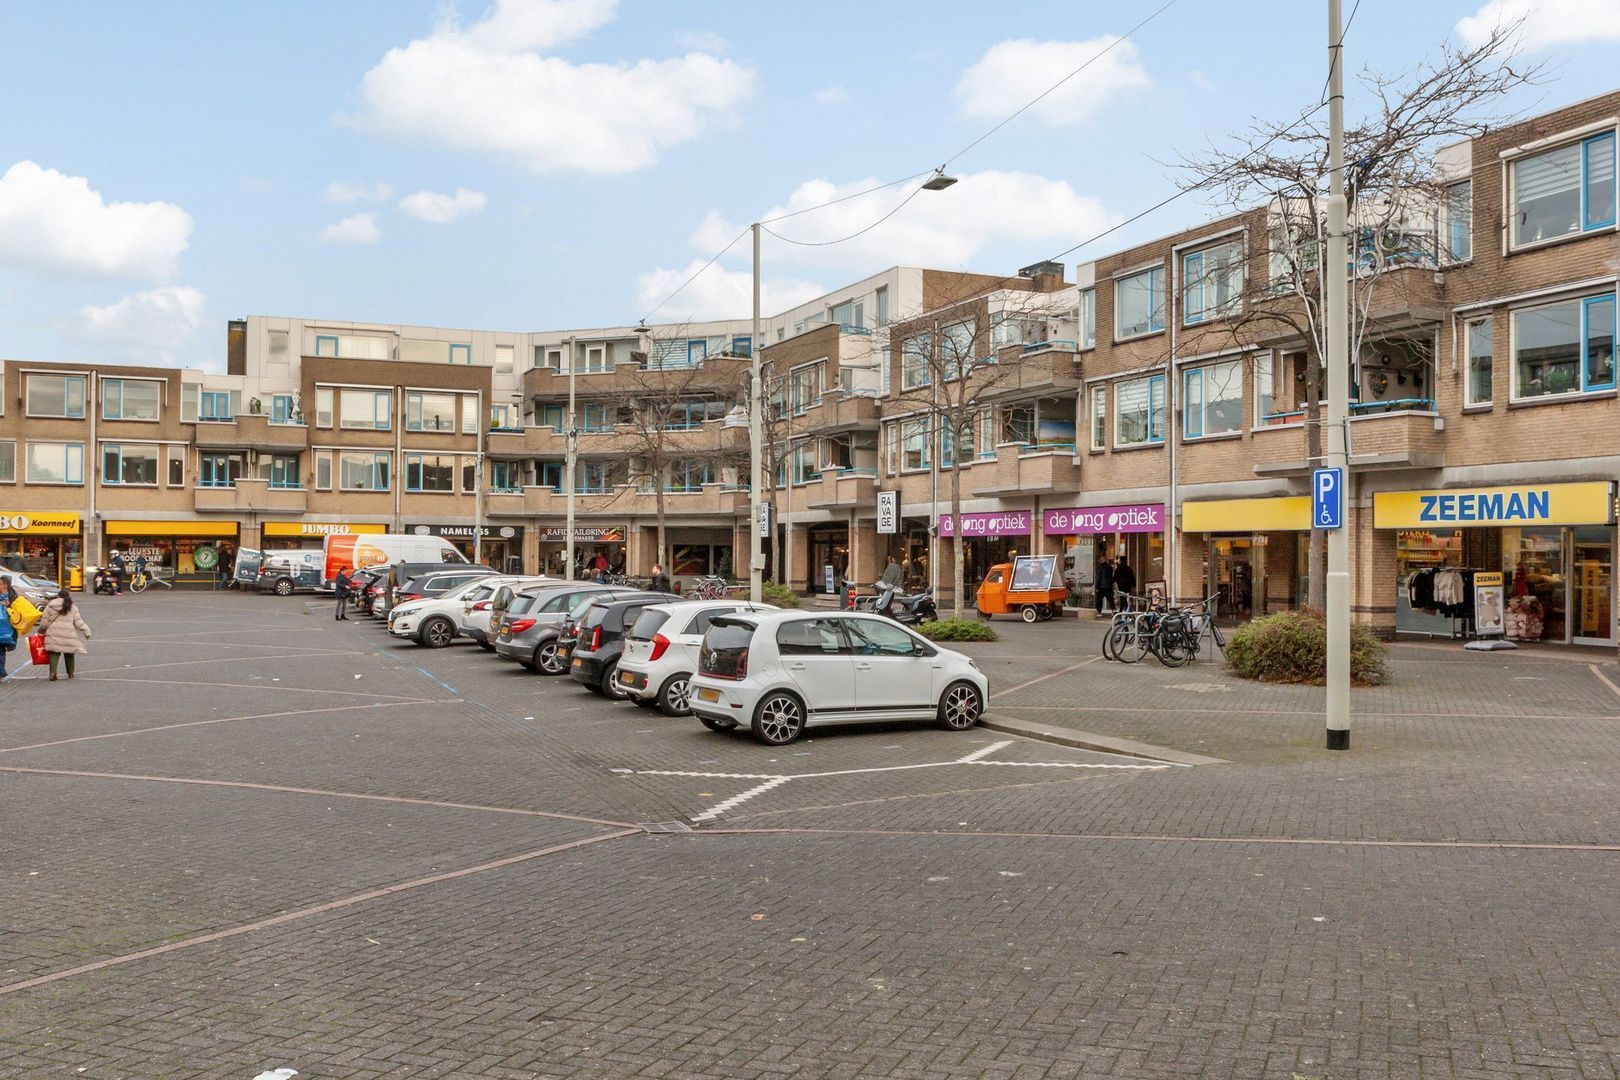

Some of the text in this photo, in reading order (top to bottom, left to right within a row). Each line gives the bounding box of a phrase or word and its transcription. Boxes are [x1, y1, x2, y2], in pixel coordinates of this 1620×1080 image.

[1320, 473, 1334, 503] P
[881, 497, 891, 506] RA
[1420, 491, 1549, 521] ZEEMAN
[881, 507, 892, 516] VA
[32, 519, 76, 529] Koornneef
[881, 517, 892, 527] GE
[961, 515, 985, 534] jong
[988, 513, 1026, 533] optiek
[1050, 508, 1158, 531] de jong optiek
[301, 524, 350, 535] JUMBO
[440, 527, 489, 535] NAMELSS
[573, 528, 609, 536] AILORING
[1476, 575, 1501, 583] ZEEMAN
